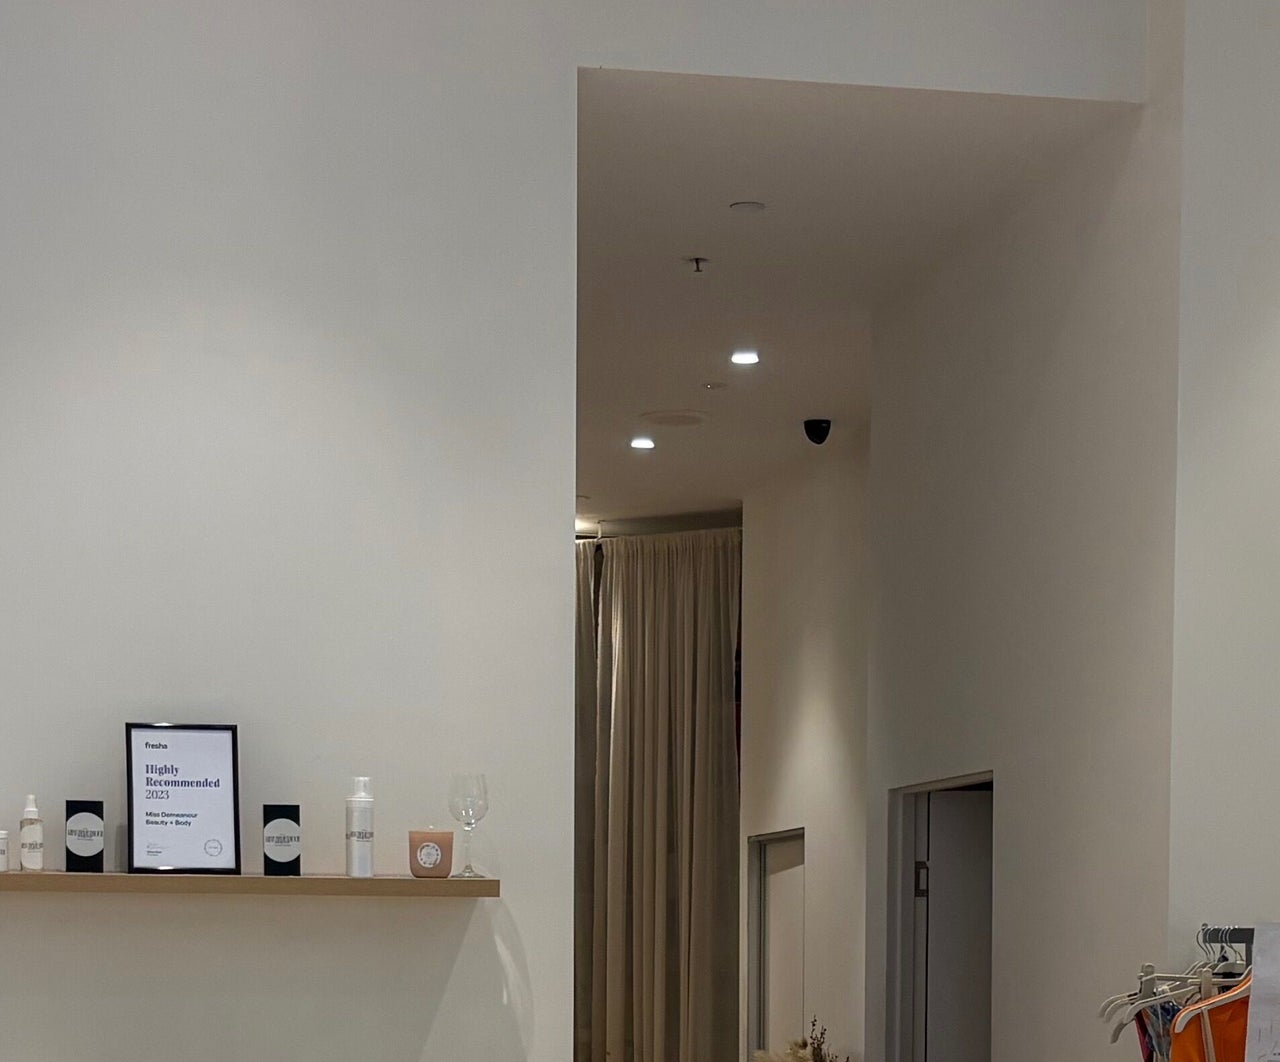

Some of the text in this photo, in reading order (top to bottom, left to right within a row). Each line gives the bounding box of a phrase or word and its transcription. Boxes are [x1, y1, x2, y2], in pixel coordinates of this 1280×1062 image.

[145, 742, 168, 750] fresha
[145, 764, 180, 777] Highly
[145, 777, 220, 788] Recommended
[145, 789, 170, 800] 2023
[175, 819, 192, 827] Body
